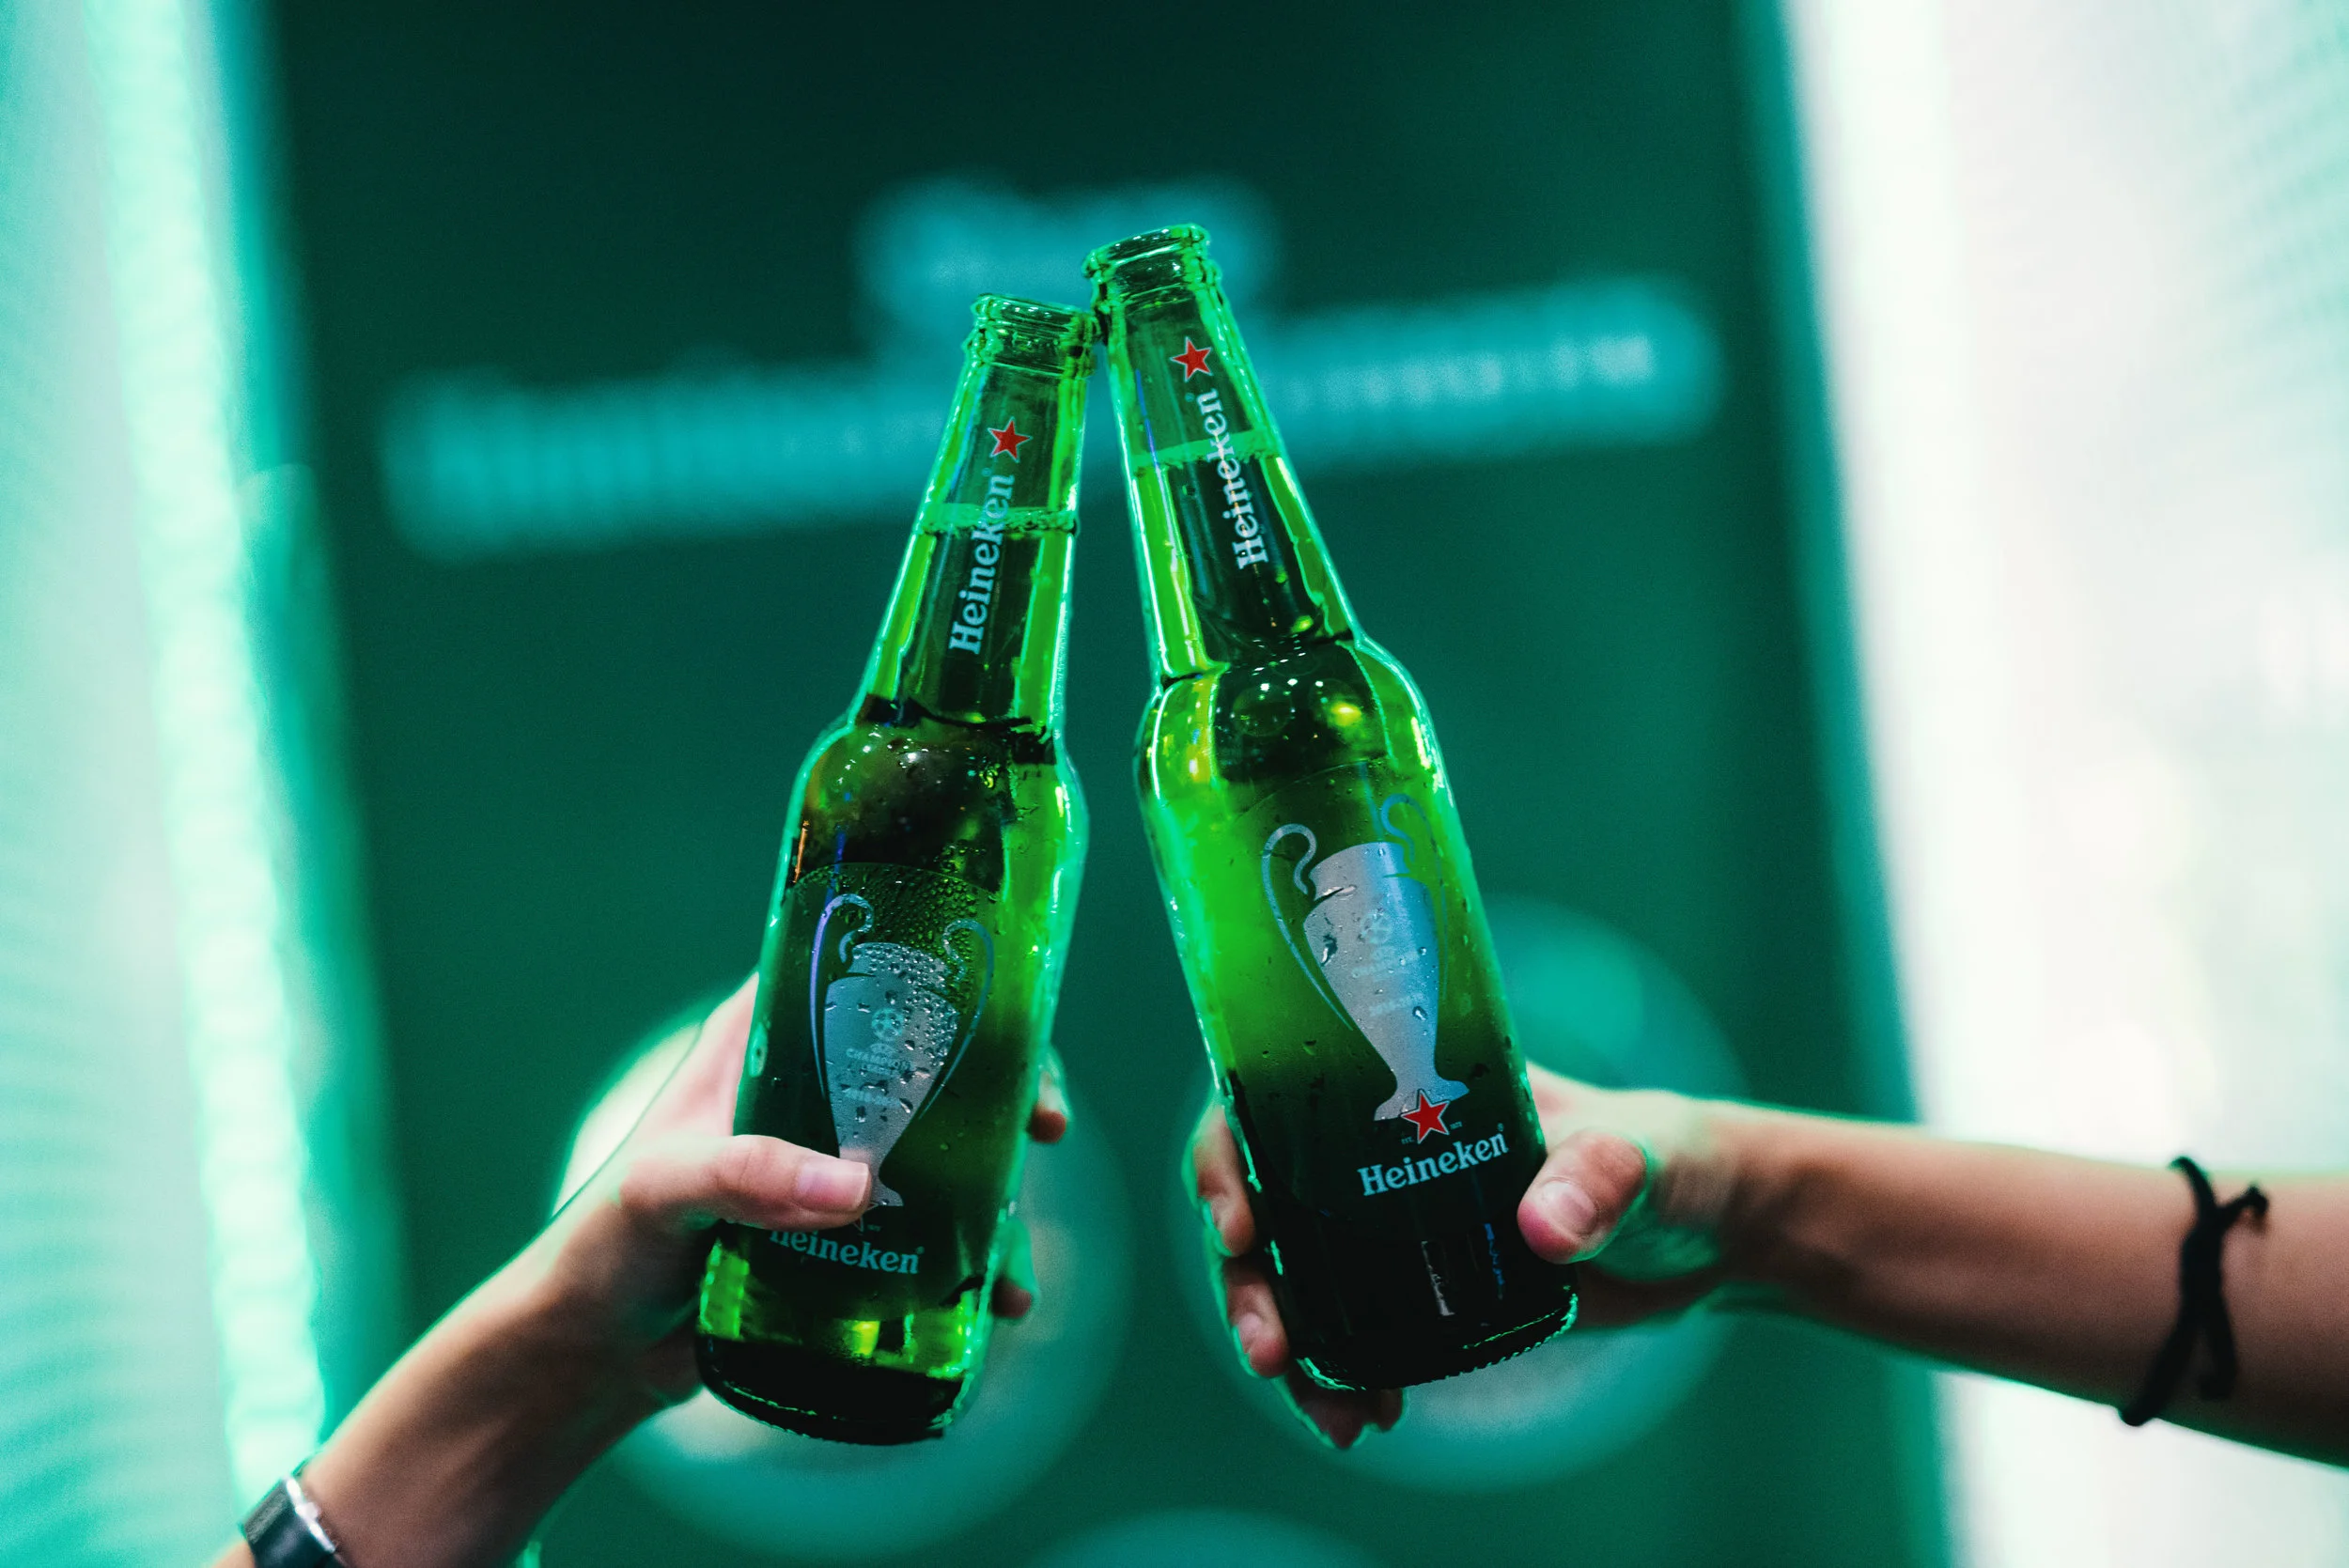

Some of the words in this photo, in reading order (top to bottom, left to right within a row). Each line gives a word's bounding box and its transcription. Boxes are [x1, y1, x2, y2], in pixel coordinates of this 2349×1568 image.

[948, 474, 1016, 655] Heineken
[1196, 387, 1268, 569] Heineken
[1357, 1131, 1509, 1197] Heineken
